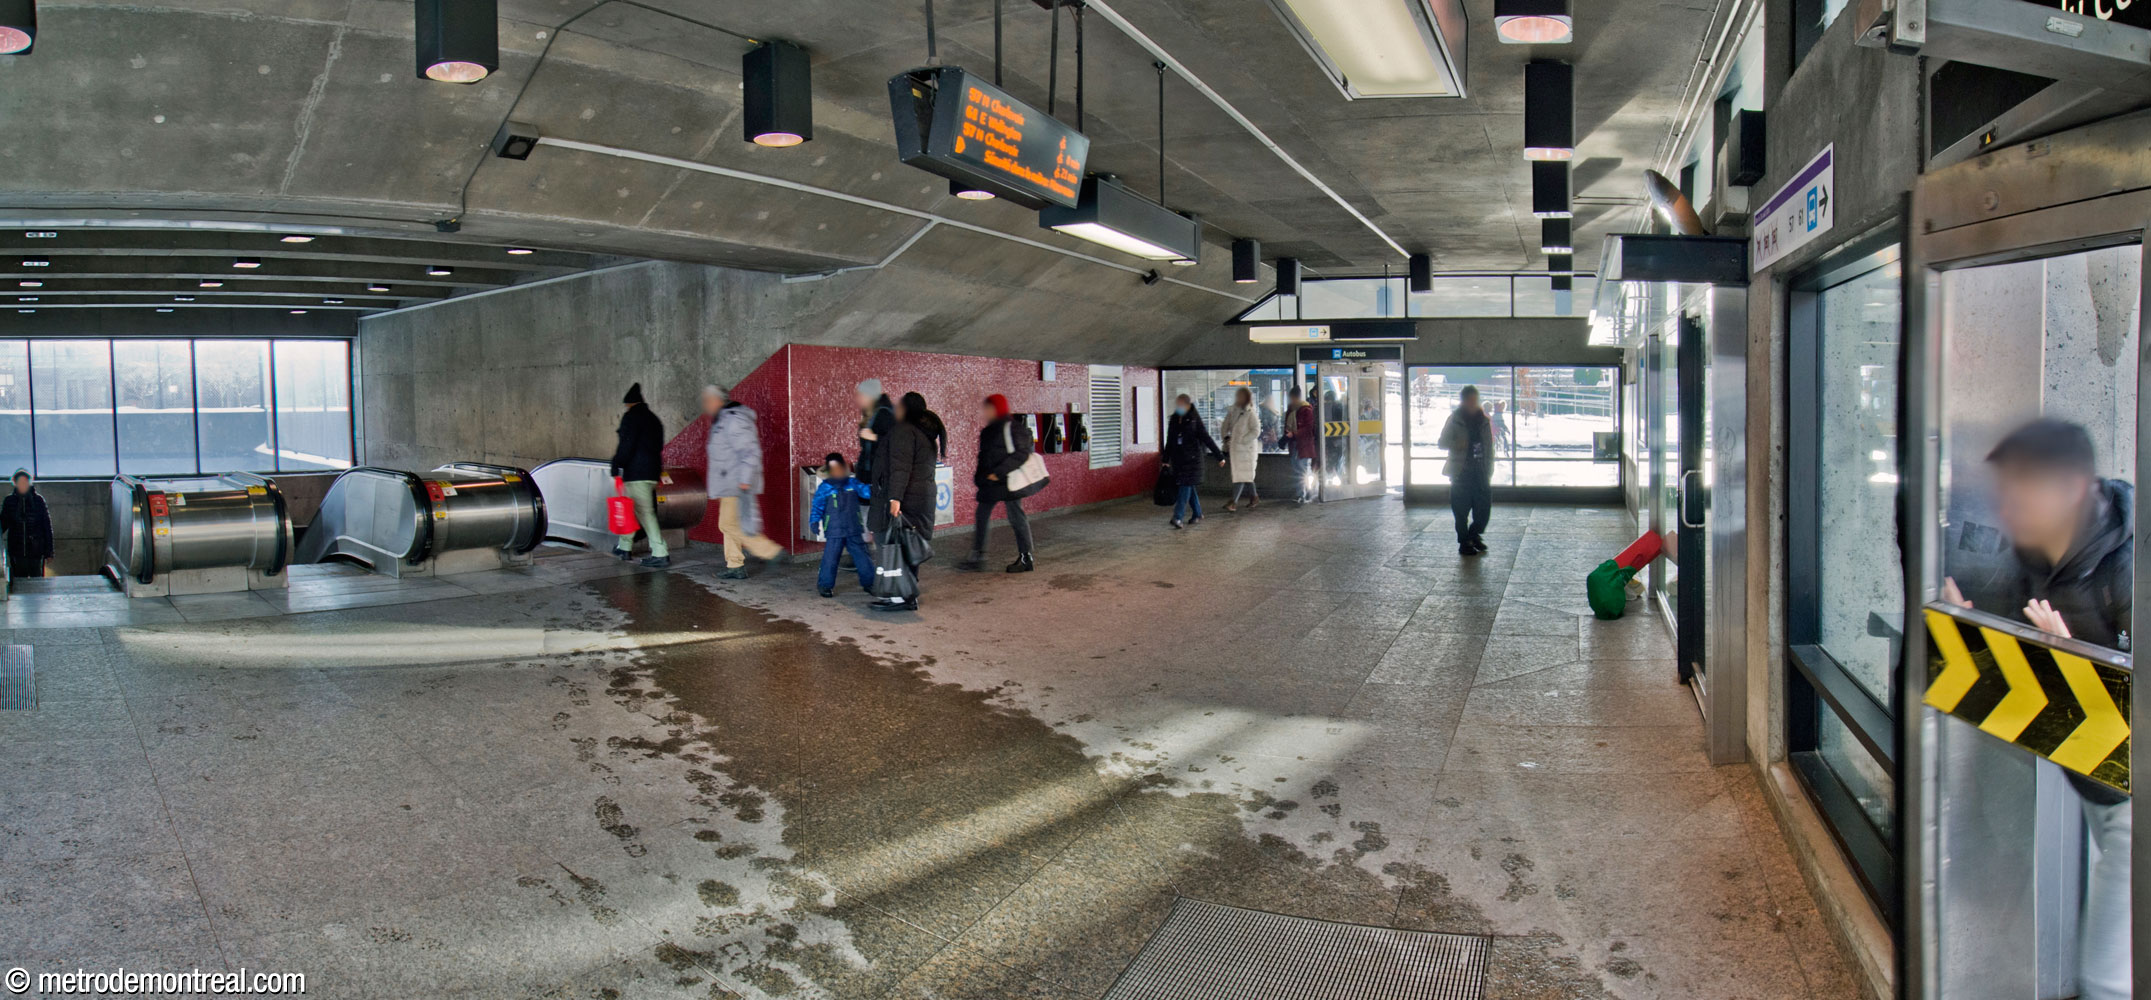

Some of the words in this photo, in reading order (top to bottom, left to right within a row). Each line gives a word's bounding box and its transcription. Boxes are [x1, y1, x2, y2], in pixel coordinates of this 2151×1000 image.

[980, 112, 988, 126] E
[963, 121, 976, 138] 57
[1342, 350, 1366, 358] Autobus
